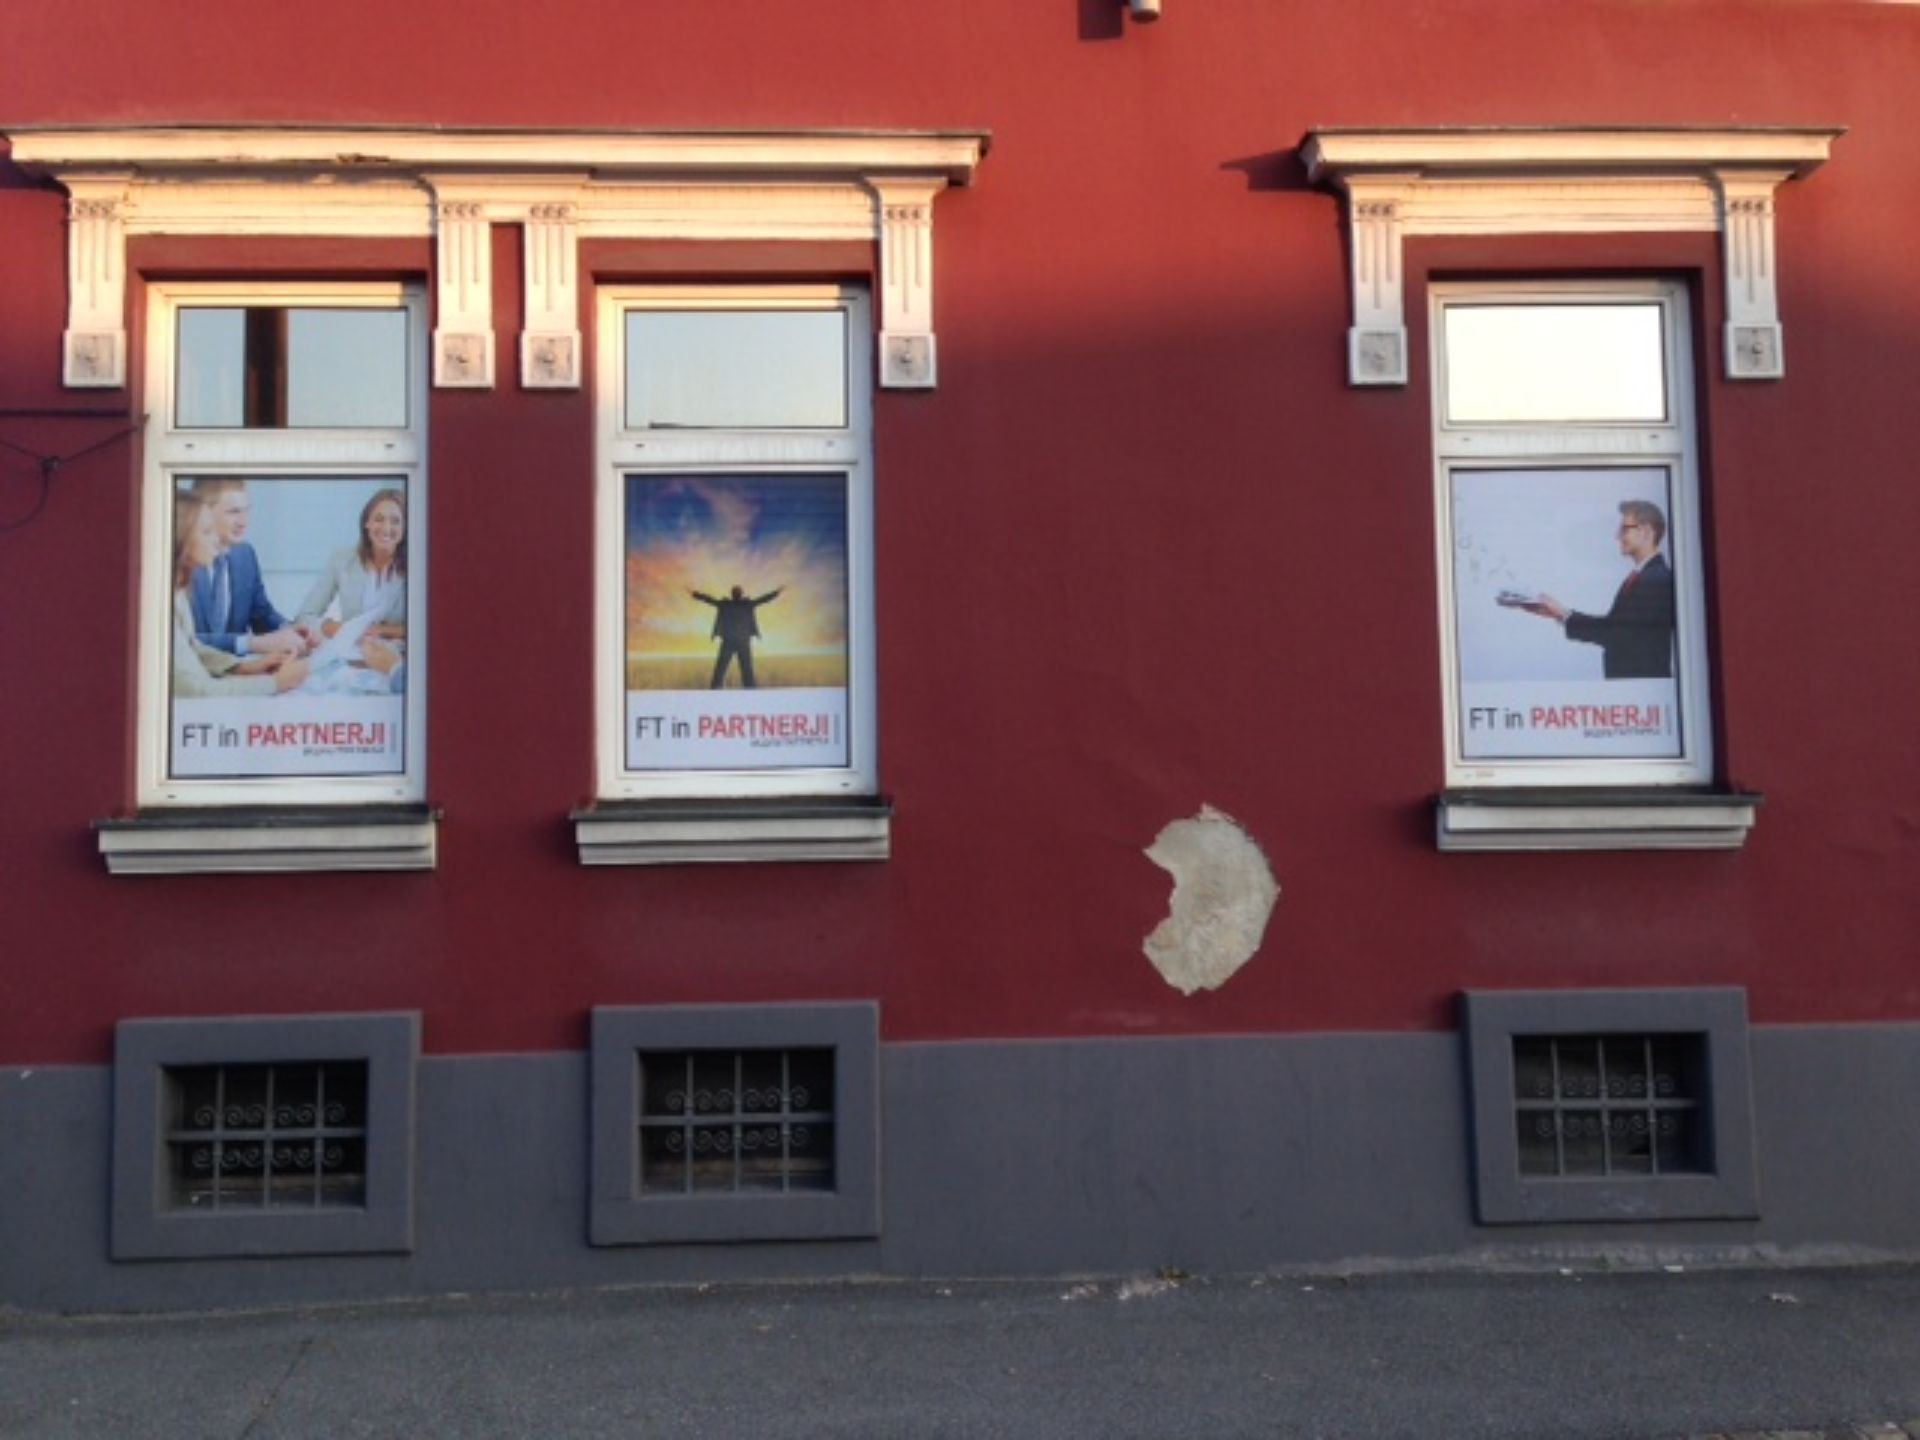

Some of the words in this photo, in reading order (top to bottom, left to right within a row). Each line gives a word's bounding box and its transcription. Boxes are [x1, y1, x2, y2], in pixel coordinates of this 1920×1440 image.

[636, 716, 664, 738] FT
[671, 716, 690, 738] in
[698, 714, 829, 738] PARTNERJI
[1469, 707, 1498, 729] FT
[1505, 707, 1524, 729] in
[1531, 705, 1660, 728] PARTNERJI
[182, 723, 213, 747] FT
[218, 723, 238, 747] in
[247, 722, 385, 747] PARTNERJI
